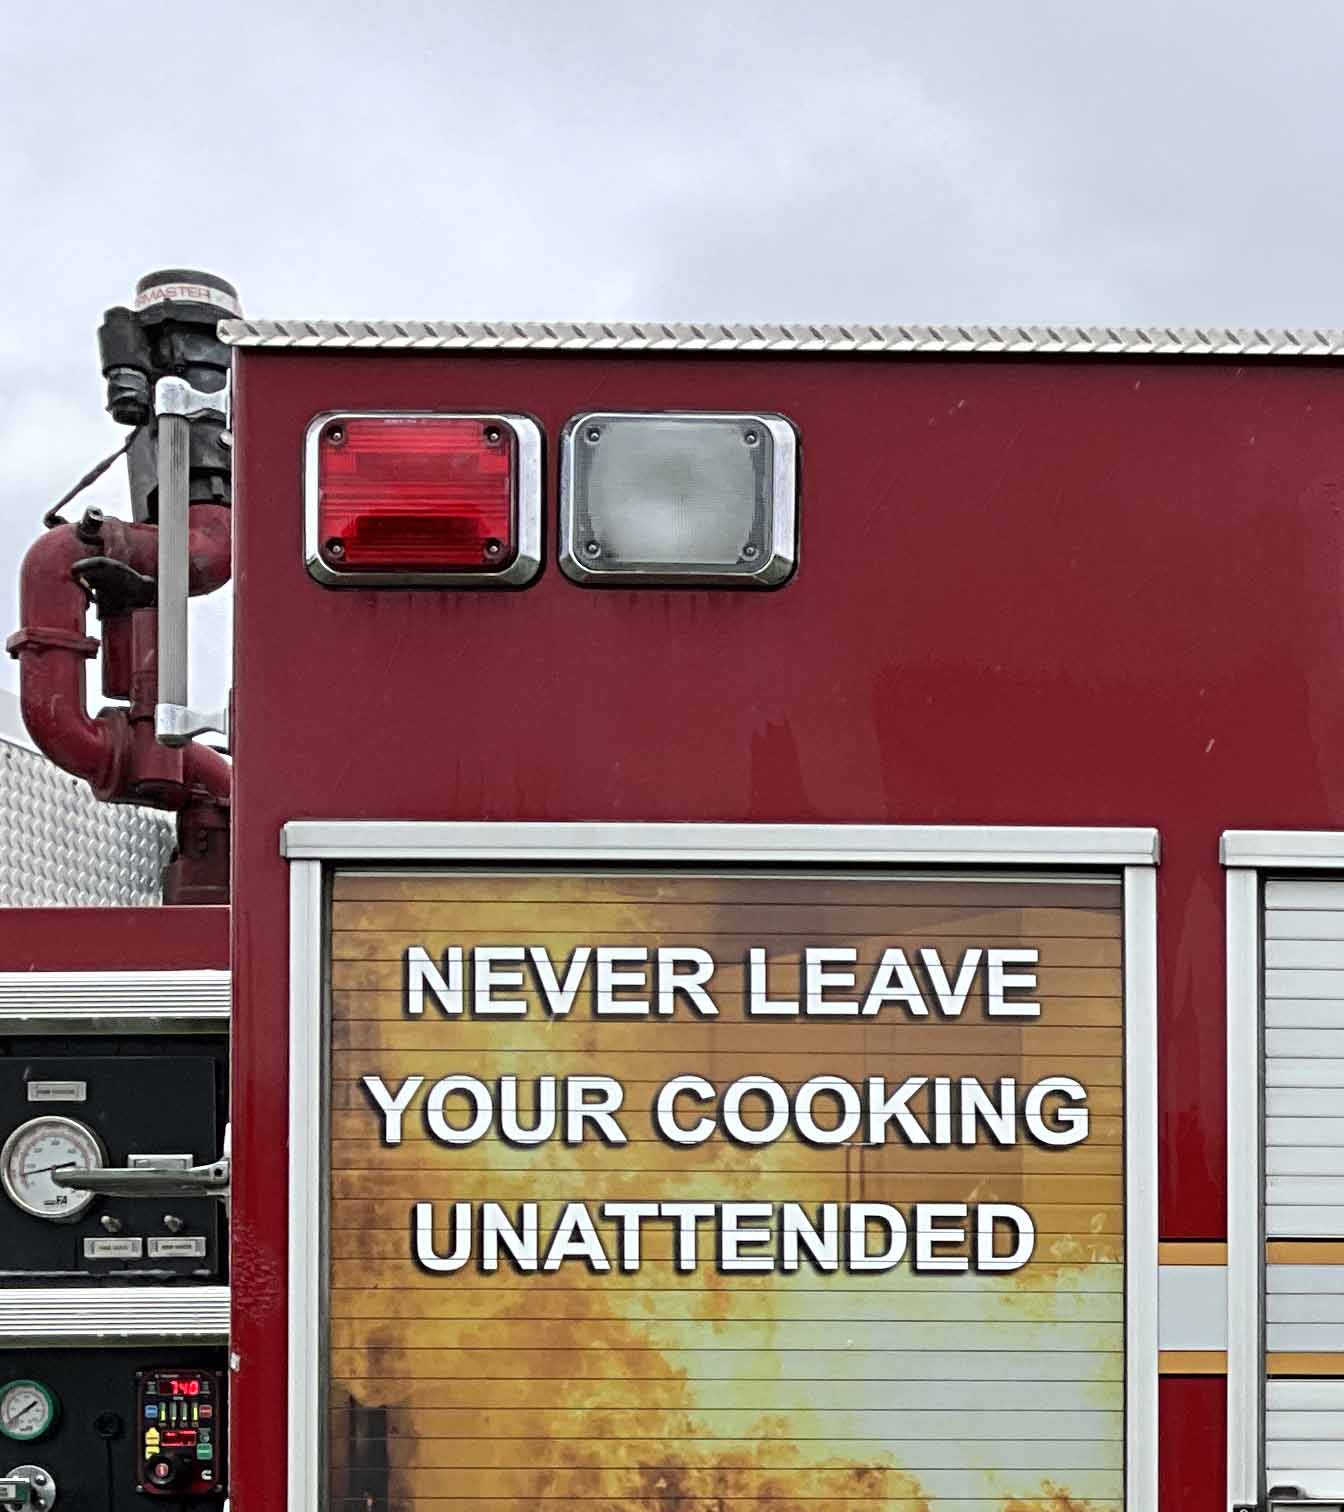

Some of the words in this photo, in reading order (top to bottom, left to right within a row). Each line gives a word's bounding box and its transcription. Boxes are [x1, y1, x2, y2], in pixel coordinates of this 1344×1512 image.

[405, 946, 720, 1016] NEVER
[749, 947, 1042, 1018] LEAVE
[360, 1075, 628, 1144] YOUR
[656, 1074, 1091, 1146] COOKING
[414, 1202, 1036, 1272] UNATTENDED
